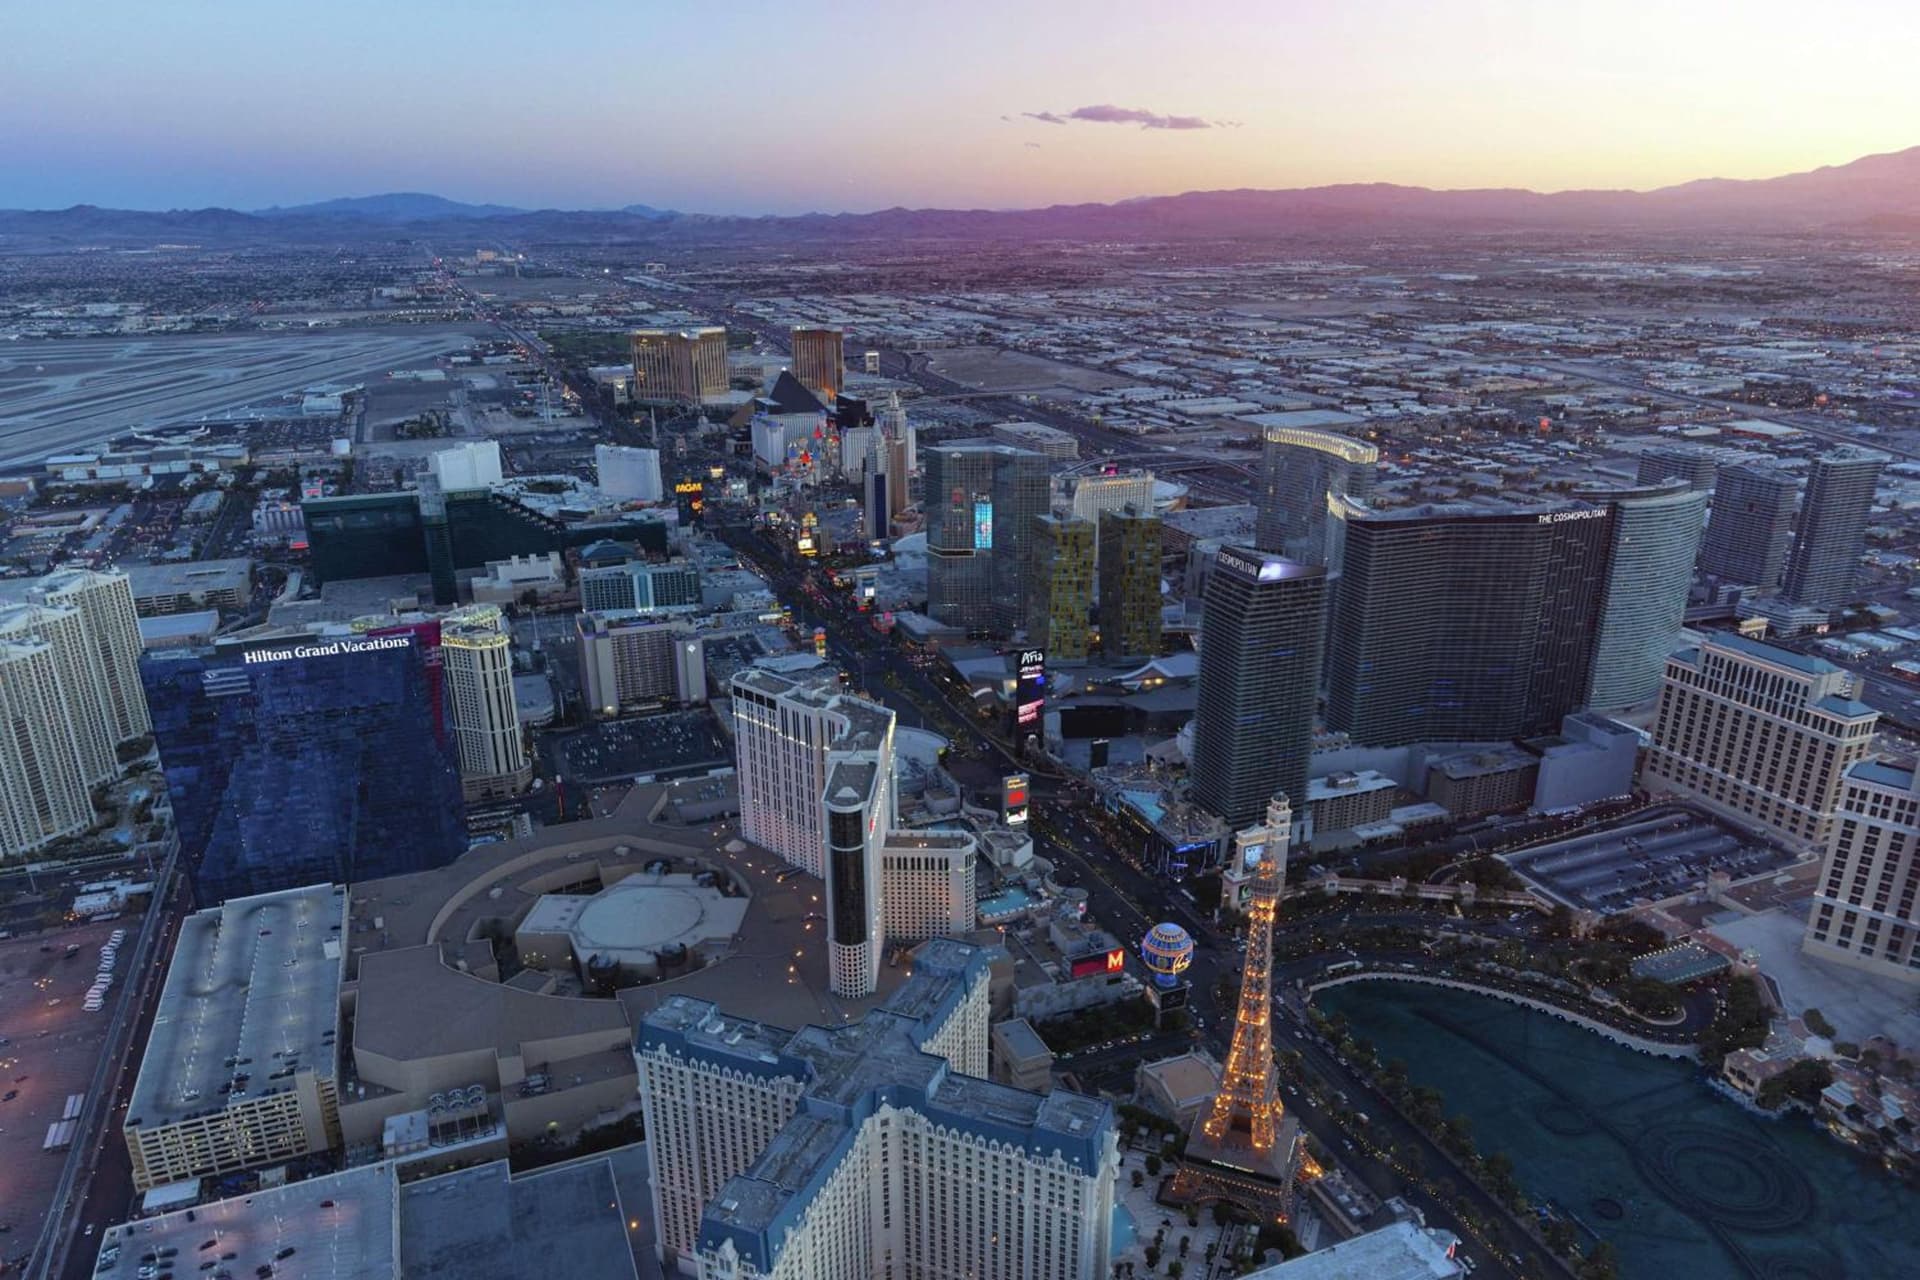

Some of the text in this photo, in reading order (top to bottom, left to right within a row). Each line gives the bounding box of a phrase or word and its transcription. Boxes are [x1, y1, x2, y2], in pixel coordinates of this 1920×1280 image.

[675, 482, 703, 493] MGM
[1538, 508, 1608, 524] THE COSMOPOLITAN
[1219, 551, 1259, 577] COSMOPOLITAN
[244, 636, 410, 664] Hilton Grand Vacations
[1107, 950, 1124, 969] M
